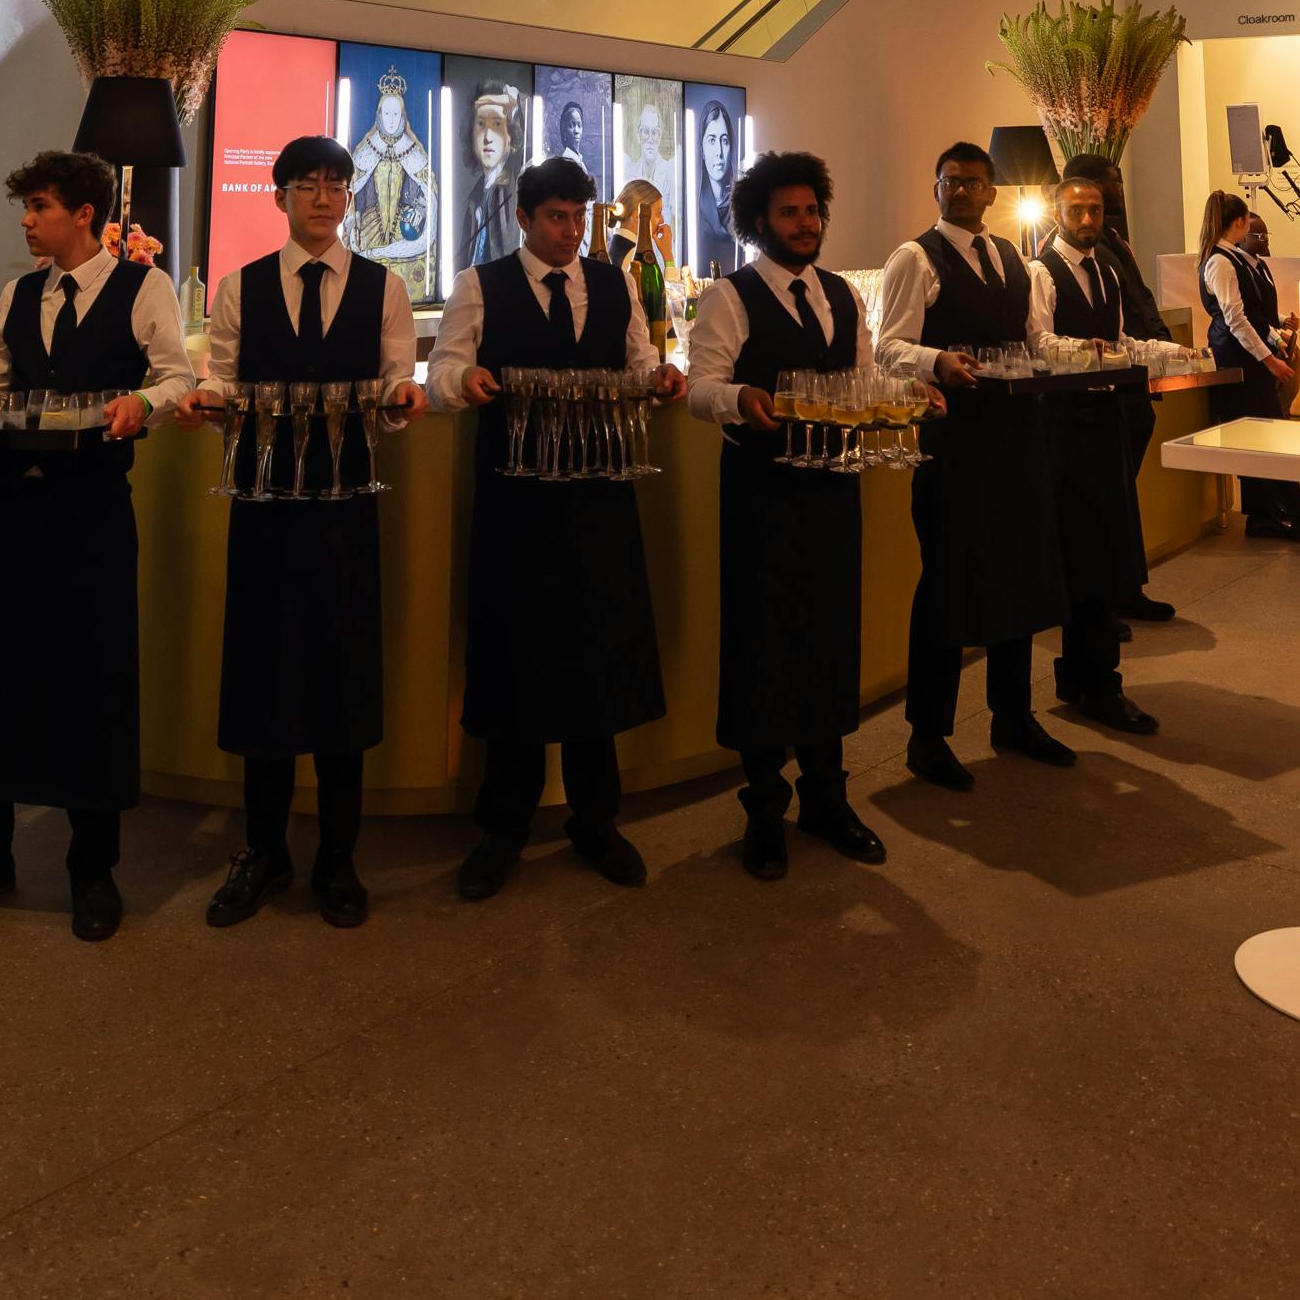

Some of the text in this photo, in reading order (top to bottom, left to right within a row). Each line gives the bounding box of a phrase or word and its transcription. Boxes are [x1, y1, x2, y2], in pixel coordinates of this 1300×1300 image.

[1237, 14, 1295, 25] Cloakroom
[222, 183, 248, 192] BANK
[250, 183, 262, 192] OF
